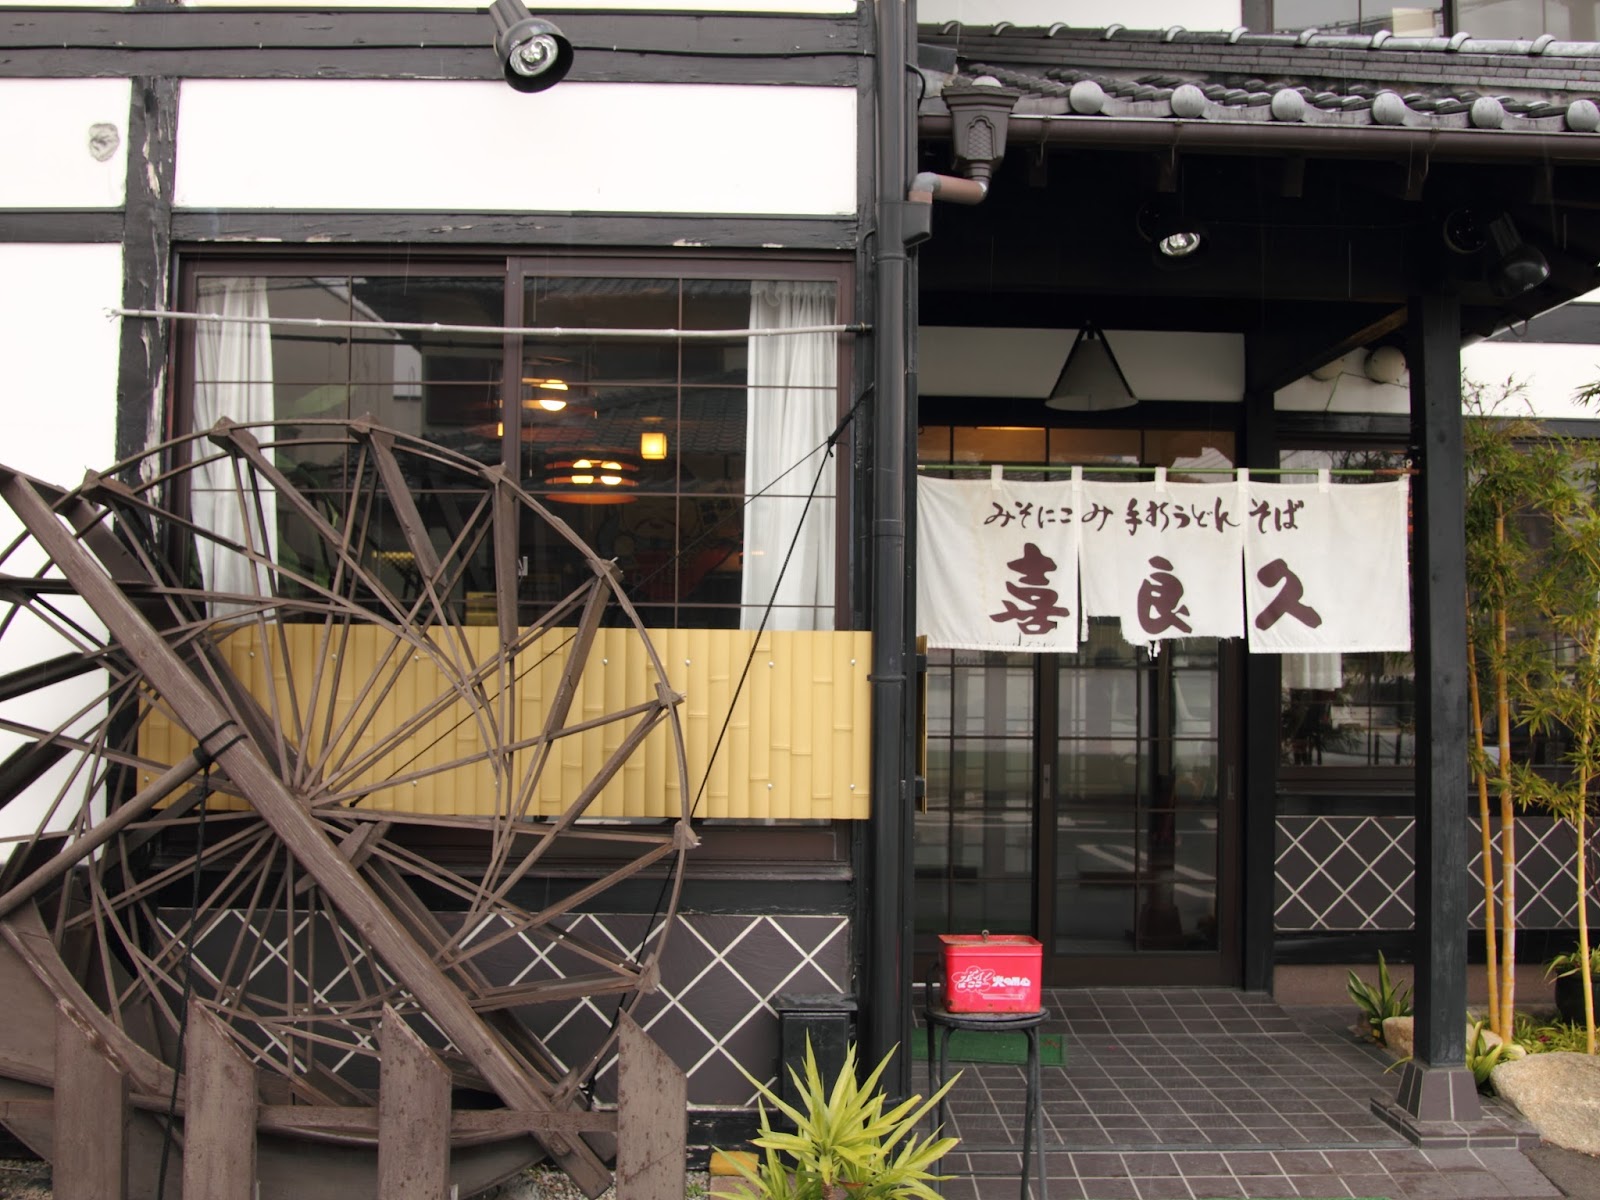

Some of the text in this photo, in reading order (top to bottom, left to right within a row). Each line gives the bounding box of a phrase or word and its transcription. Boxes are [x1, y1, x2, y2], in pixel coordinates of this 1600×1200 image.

[983, 501, 1114, 532] みそにこみ
[1248, 499, 1305, 534] そば
[989, 542, 1323, 635] 喜良久
